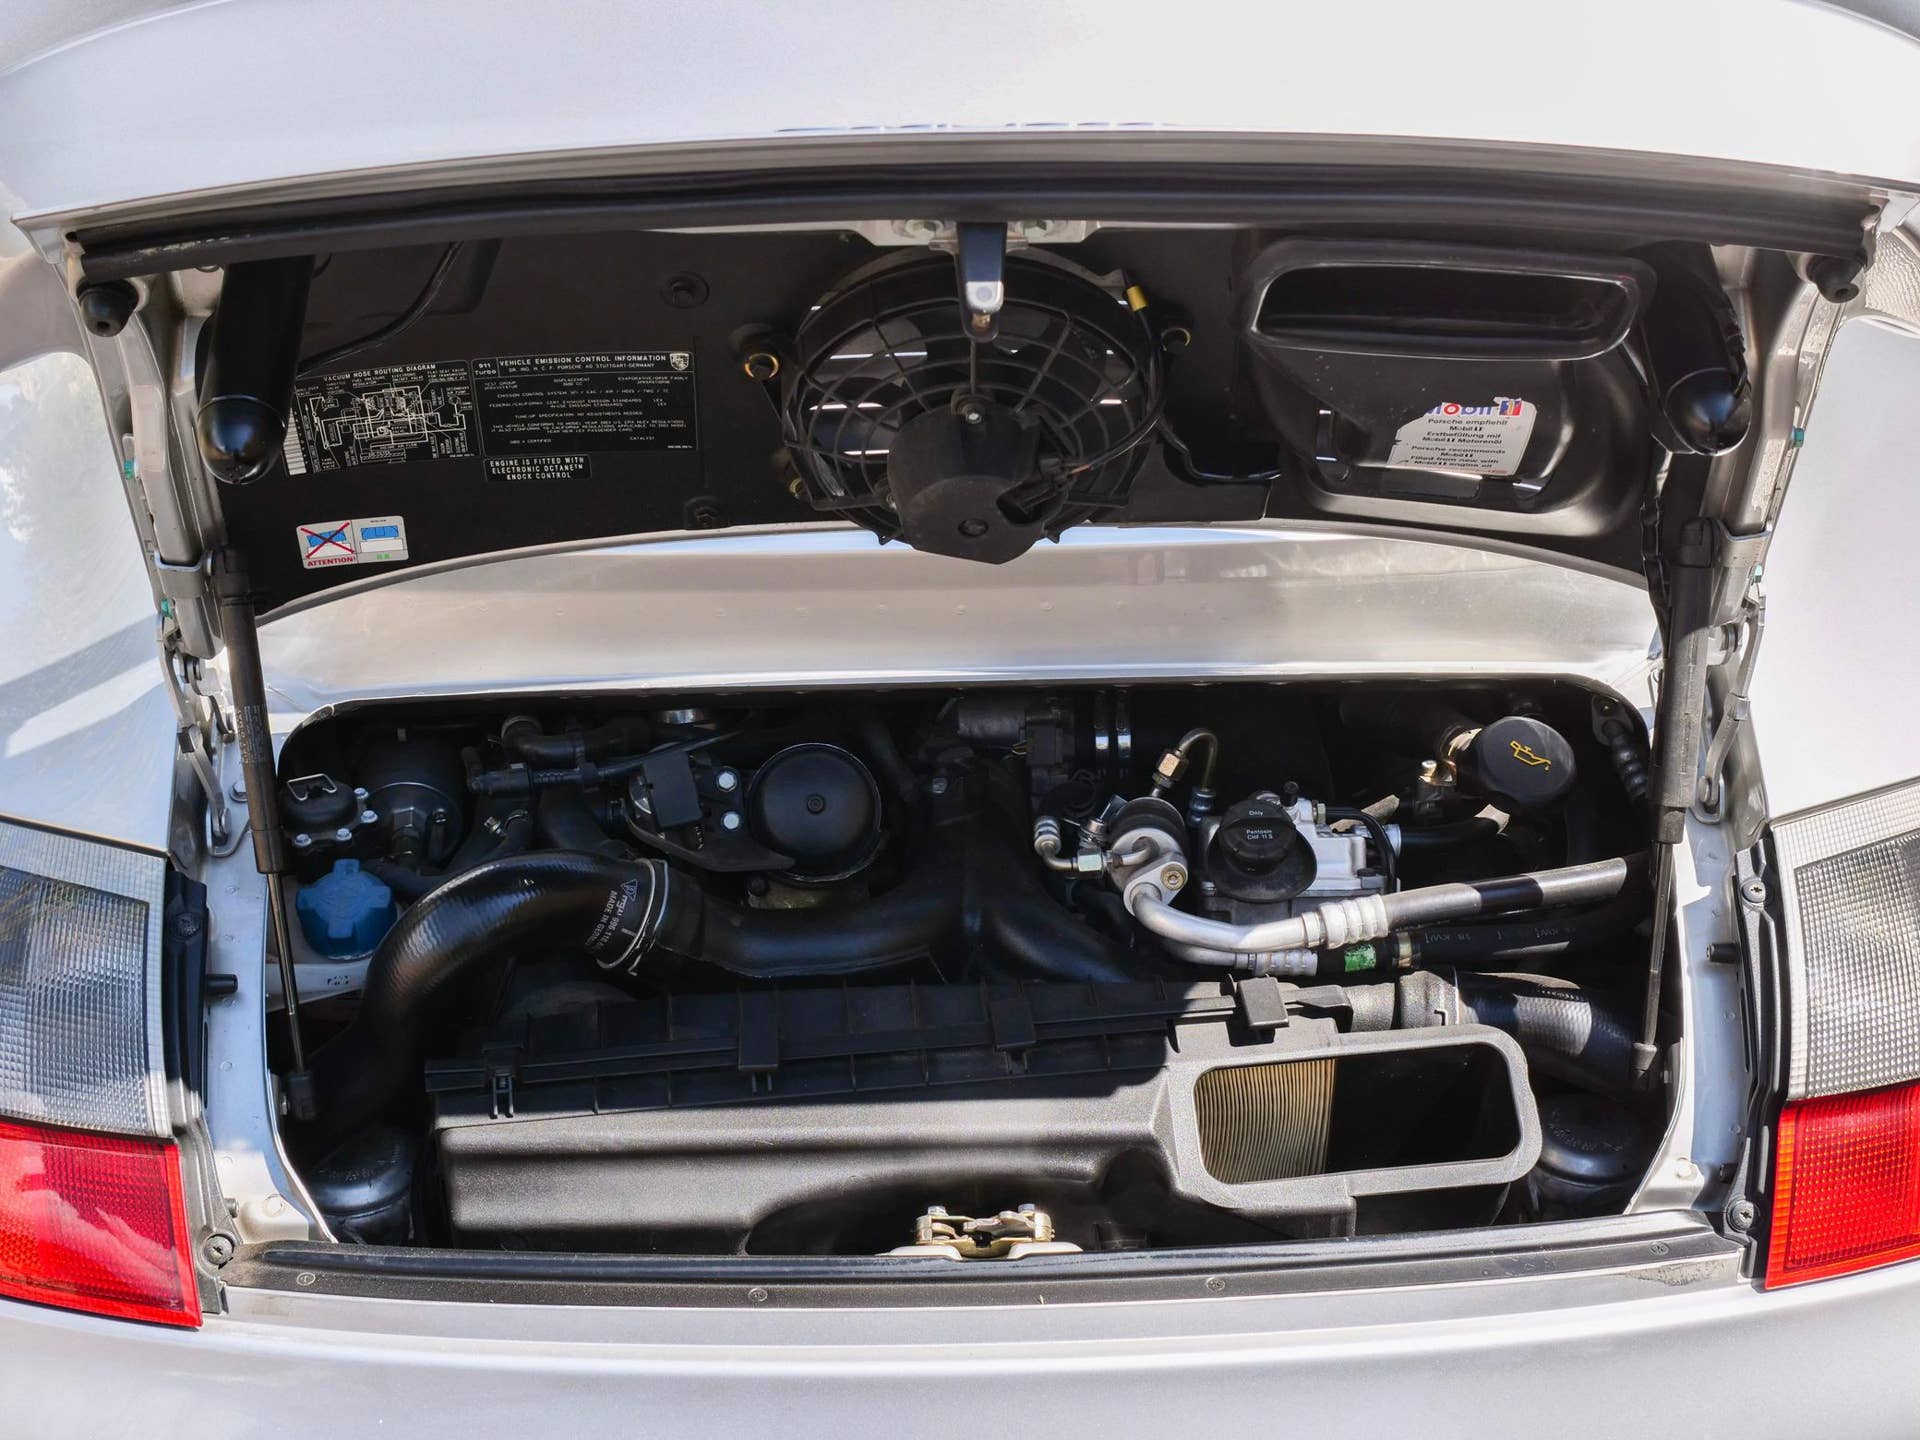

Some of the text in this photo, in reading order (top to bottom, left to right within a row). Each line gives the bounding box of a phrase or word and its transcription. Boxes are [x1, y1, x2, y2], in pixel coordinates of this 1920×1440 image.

[324, 374, 350, 382] VACUUM
[406, 364, 436, 372] DIAGRAM
[490, 456, 584, 467] ENGINE IS FITTED WITH
[492, 465, 540, 475] ELECTRONIC
[307, 556, 356, 567] ATTENTION!
[604, 890, 618, 913] MADE
[600, 912, 609, 923] IN
